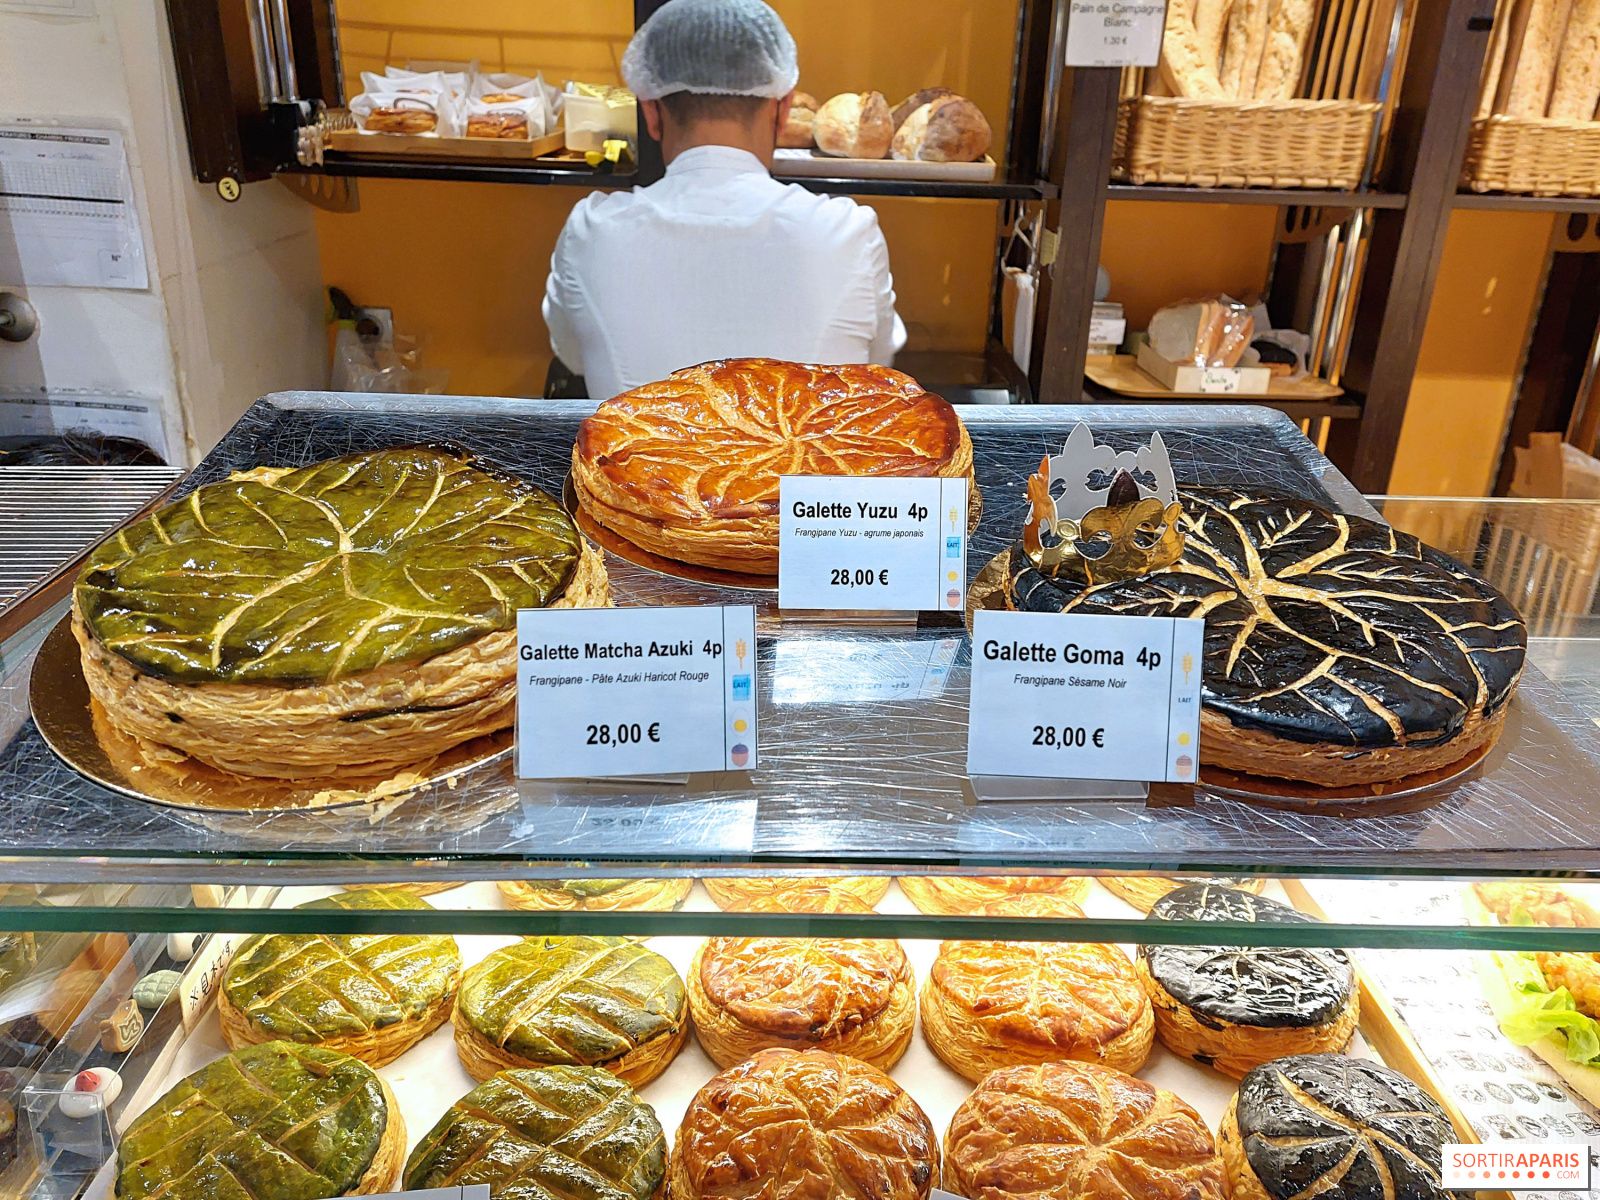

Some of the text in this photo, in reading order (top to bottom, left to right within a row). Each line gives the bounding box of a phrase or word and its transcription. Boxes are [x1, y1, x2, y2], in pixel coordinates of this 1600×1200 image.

[1072, 3, 1164, 16] Pain de Campagne
[1104, 17, 1132, 28] Blanc
[793, 501, 928, 522] Galette Yuzu 4p
[795, 528, 837, 538] Frangipane
[838, 528, 858, 537] Yuzu
[863, 530, 891, 538] agrume
[892, 528, 924, 538] japonais
[830, 569, 889, 588] 28,00 €
[520, 639, 722, 661] Galette Matcha Azuki 4p
[983, 640, 1162, 671] Galette Goma 4p
[529, 675, 583, 688] Frangipane
[592, 673, 614, 684] Pâte
[616, 672, 641, 683] Azuki
[644, 671, 677, 682] Haricot
[679, 670, 709, 683] Rouge
[1013, 673, 1127, 689] Frangipane Sésame Noir
[586, 722, 661, 748] 28,00 €
[1032, 725, 1105, 750] 28,00 €
